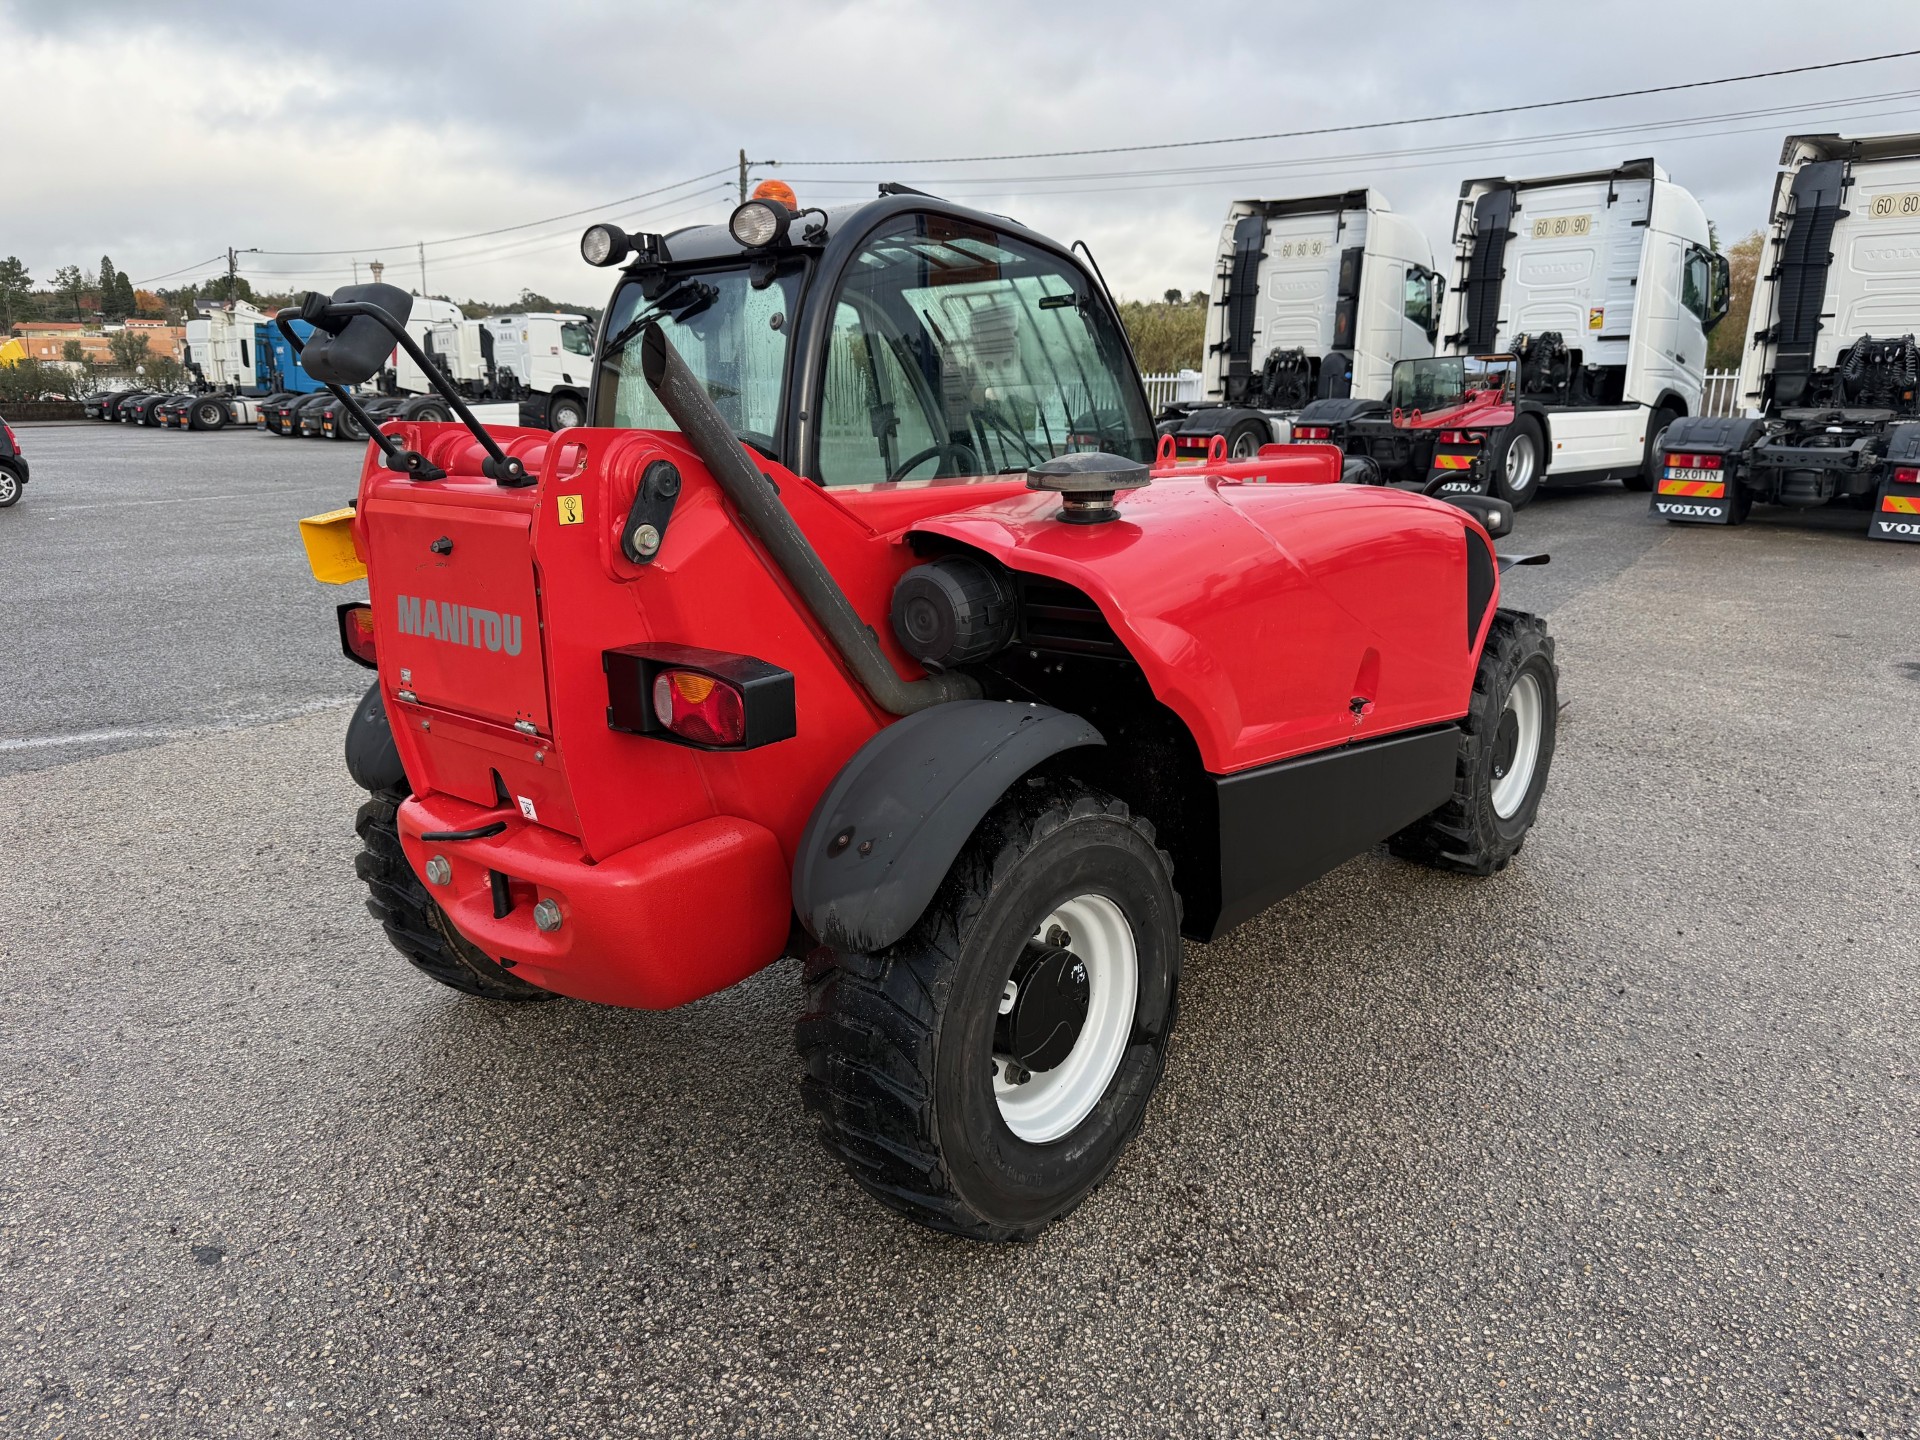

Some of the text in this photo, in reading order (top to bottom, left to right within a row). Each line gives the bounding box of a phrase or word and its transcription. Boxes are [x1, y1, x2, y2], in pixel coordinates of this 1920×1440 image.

[1876, 196, 1919, 214] 60 80
[1536, 218, 1586, 236] 60 80 90
[1283, 242, 1321, 257] 60 80 90
[1527, 262, 1584, 276] VOLVO
[1440, 482, 1482, 493] OLVO
[1655, 502, 1722, 517] VOLVO
[397, 594, 522, 657] MANITOU
